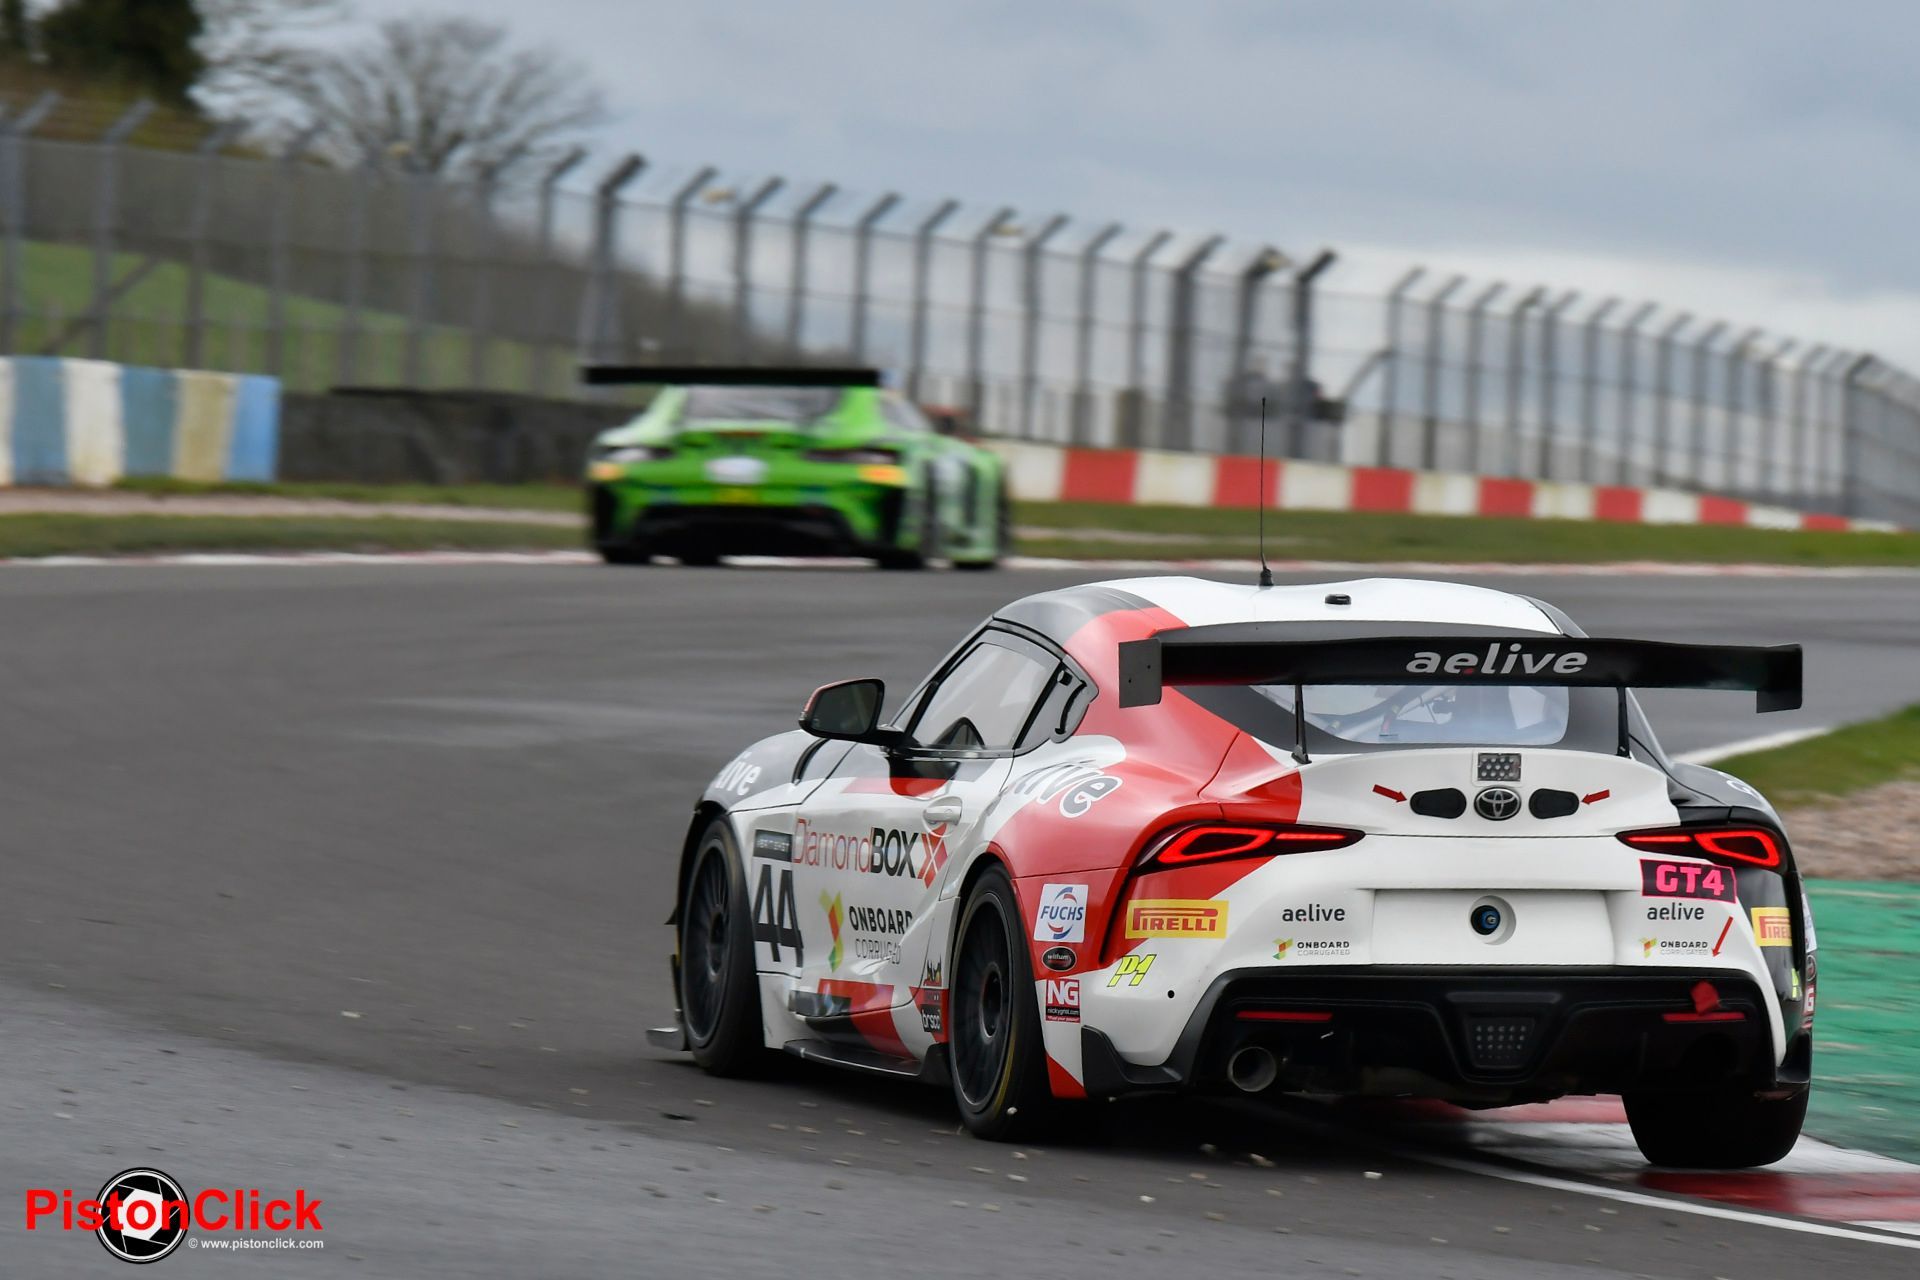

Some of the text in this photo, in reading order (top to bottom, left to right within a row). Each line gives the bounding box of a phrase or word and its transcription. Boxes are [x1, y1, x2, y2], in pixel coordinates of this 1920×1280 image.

[1656, 864, 1724, 896] GT4
[753, 864, 804, 968] 44
[1040, 905, 1084, 922] FUCHS
[1132, 907, 1219, 932] PIRELLI
[1759, 915, 1792, 939] PIRE
[1297, 941, 1350, 949] ONBOARD
[1047, 979, 1079, 1006] NG
